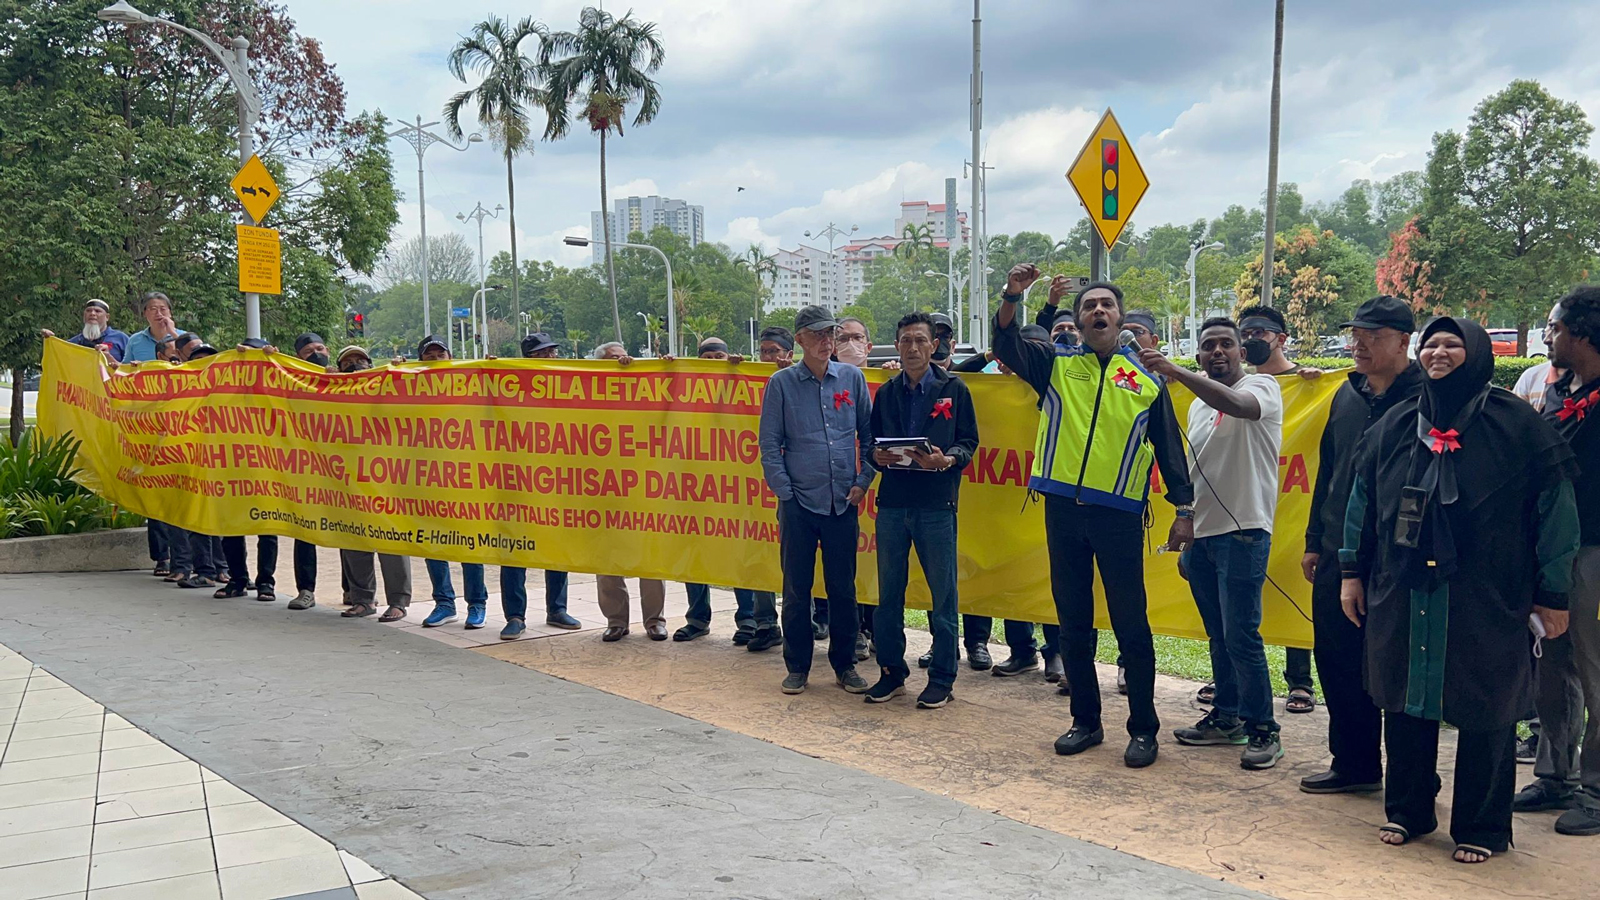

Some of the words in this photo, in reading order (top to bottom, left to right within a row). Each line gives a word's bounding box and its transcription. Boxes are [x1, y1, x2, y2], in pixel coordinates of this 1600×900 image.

[256, 230, 273, 238] TUNDA
[142, 374, 168, 394] JIKA
[262, 366, 319, 394] KAWAL
[321, 374, 398, 396] HARGA
[401, 374, 524, 402] TAMBANG,
[530, 374, 586, 400] SILA
[591, 376, 674, 402] LETAK
[678, 378, 764, 406] JAWAT
[288, 410, 392, 446] KAWALAN
[395, 418, 476, 450] HARGA
[480, 419, 612, 456] TAMBANG
[618, 424, 760, 464] E-HAILING
[232, 443, 350, 486] PENUMPANG,
[357, 456, 410, 485] LOW
[416, 460, 472, 489] FARE
[478, 462, 638, 498] MENGHISAP
[645, 470, 740, 504] DARAH
[198, 479, 225, 498] YANG
[228, 480, 270, 496] TIDAK
[273, 482, 302, 504] STABIL
[306, 488, 346, 510] HANYA
[346, 492, 480, 521] MENGUNTUNGKAN
[484, 502, 560, 527] KAPITALIS
[563, 508, 600, 529] EHO
[606, 510, 700, 535] MAHAKAYA
[704, 516, 740, 538] DAN
[743, 521, 780, 544] MAH
[250, 508, 293, 524] Gerakan
[320, 518, 366, 538] Bertindak
[368, 524, 413, 542] Sahabat
[416, 530, 474, 550] E-Hailing
[478, 533, 536, 552] Malaysia
